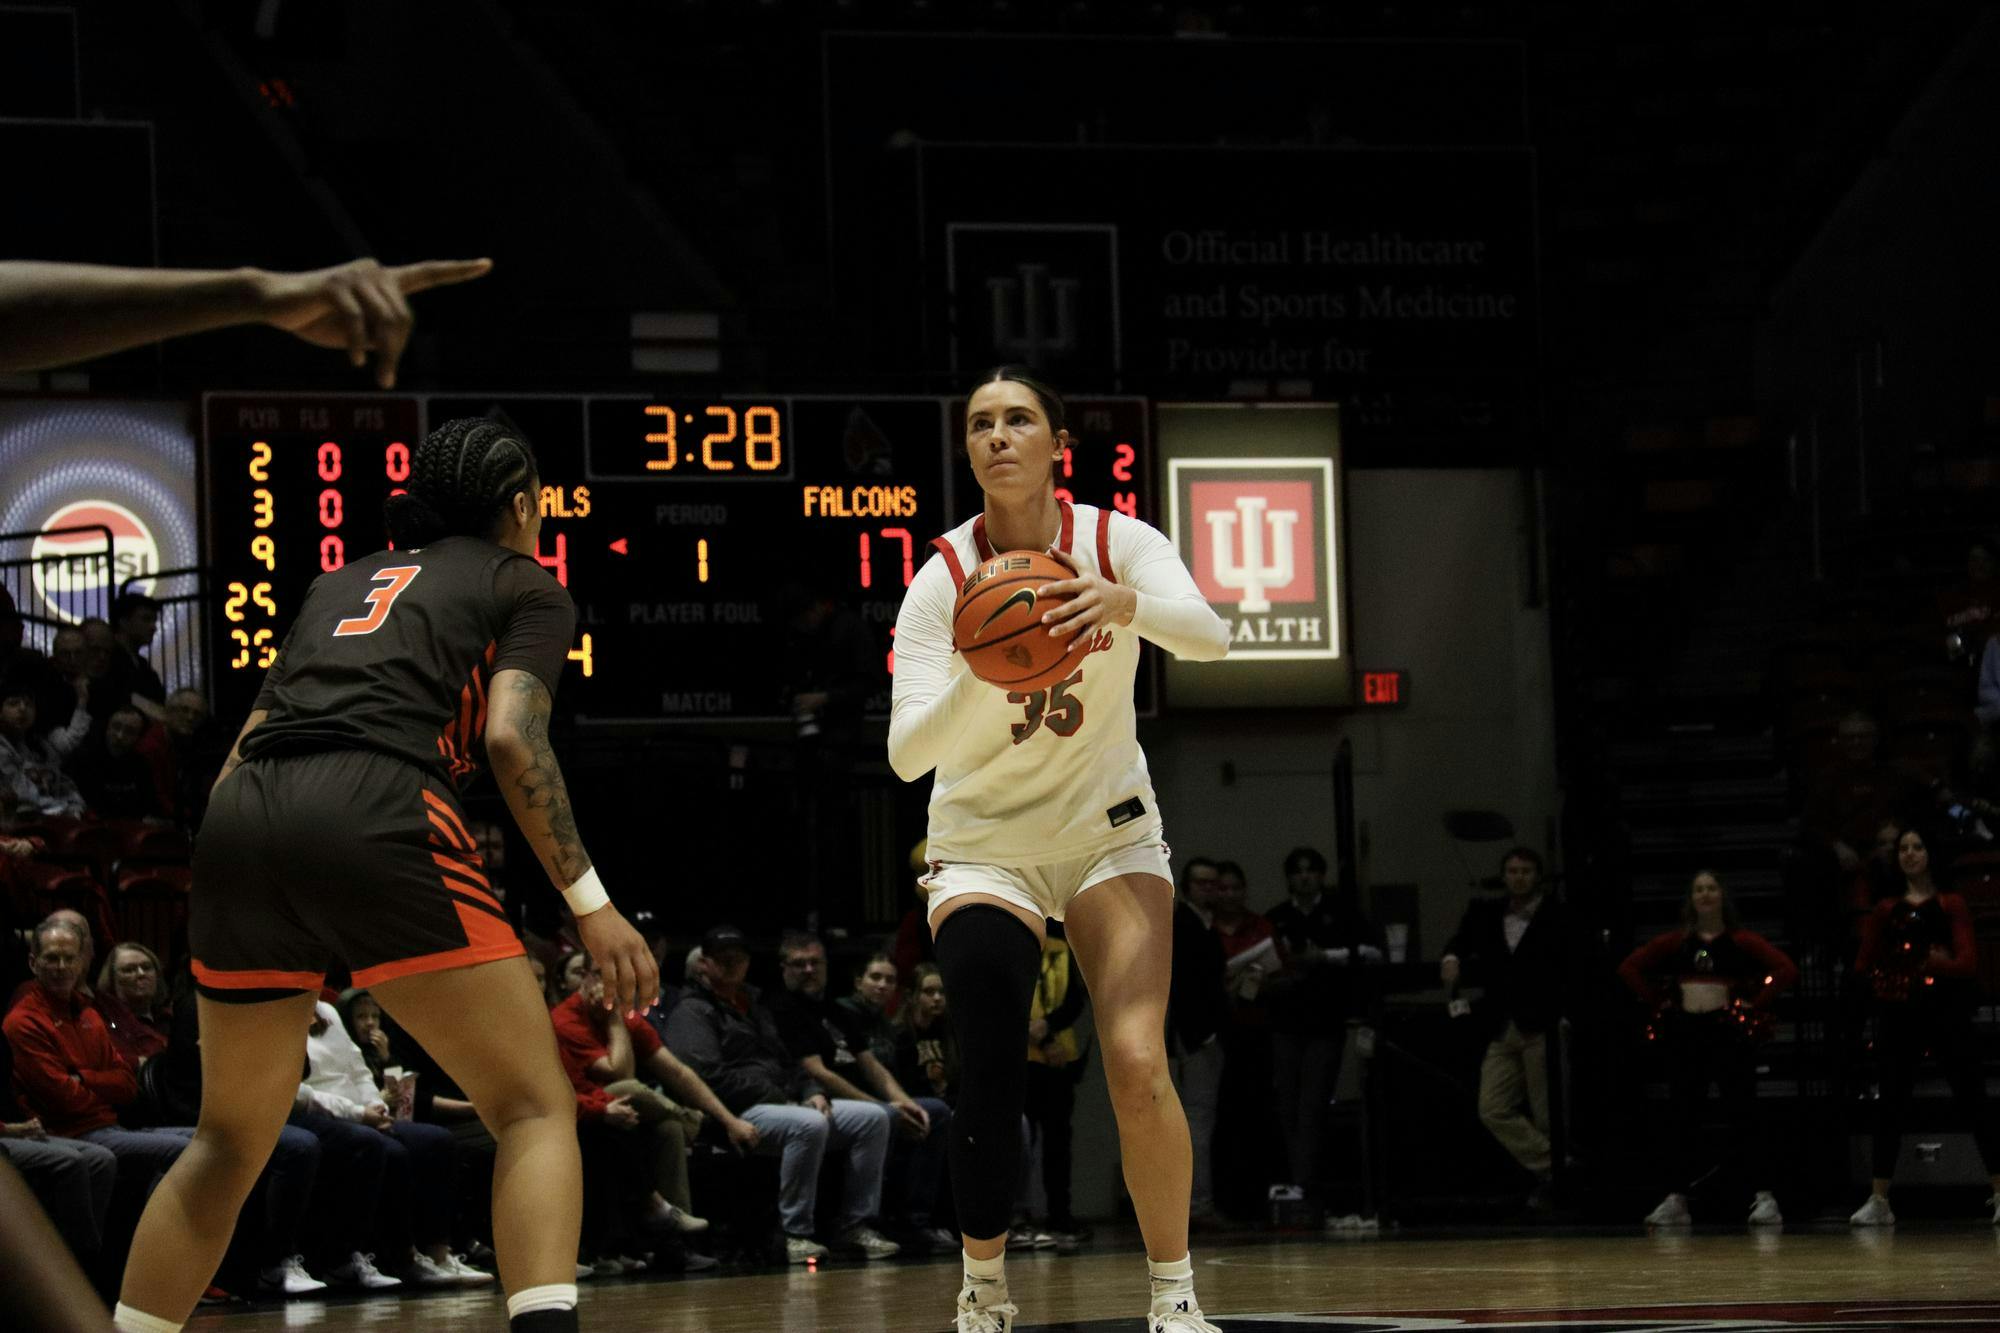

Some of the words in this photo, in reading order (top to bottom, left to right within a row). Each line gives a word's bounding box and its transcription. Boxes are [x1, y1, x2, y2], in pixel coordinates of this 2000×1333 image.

[1162, 231, 1288, 265] Official
[1302, 231, 1486, 265] Healthcare
[1163, 285, 1228, 319] and
[1239, 285, 1344, 327] Sports
[1358, 285, 1517, 319] Medicine
[1168, 339, 1312, 374] Provider
[1322, 338, 1372, 373] for
[644, 406, 781, 470] 3:28
[249, 442, 273, 481] 2
[318, 442, 342, 482] 0
[386, 442, 410, 482] 0
[1113, 442, 1136, 481] 2
[253, 488, 274, 528] 3
[319, 488, 344, 528] 0
[656, 504, 728, 525] PERIOD
[804, 486, 918, 518] FALCONS
[251, 534, 275, 571] 9
[320, 535, 345, 573] 0
[697, 539, 709, 582] 1
[859, 528, 914, 589] 17
[225, 582, 277, 622] 25
[332, 565, 421, 637] 3
[629, 603, 707, 624] PLAYER
[712, 603, 763, 624] FOUL
[661, 691, 733, 712] MATCH
[1006, 669, 1085, 746] 35
[1364, 673, 1399, 703] EXIT
